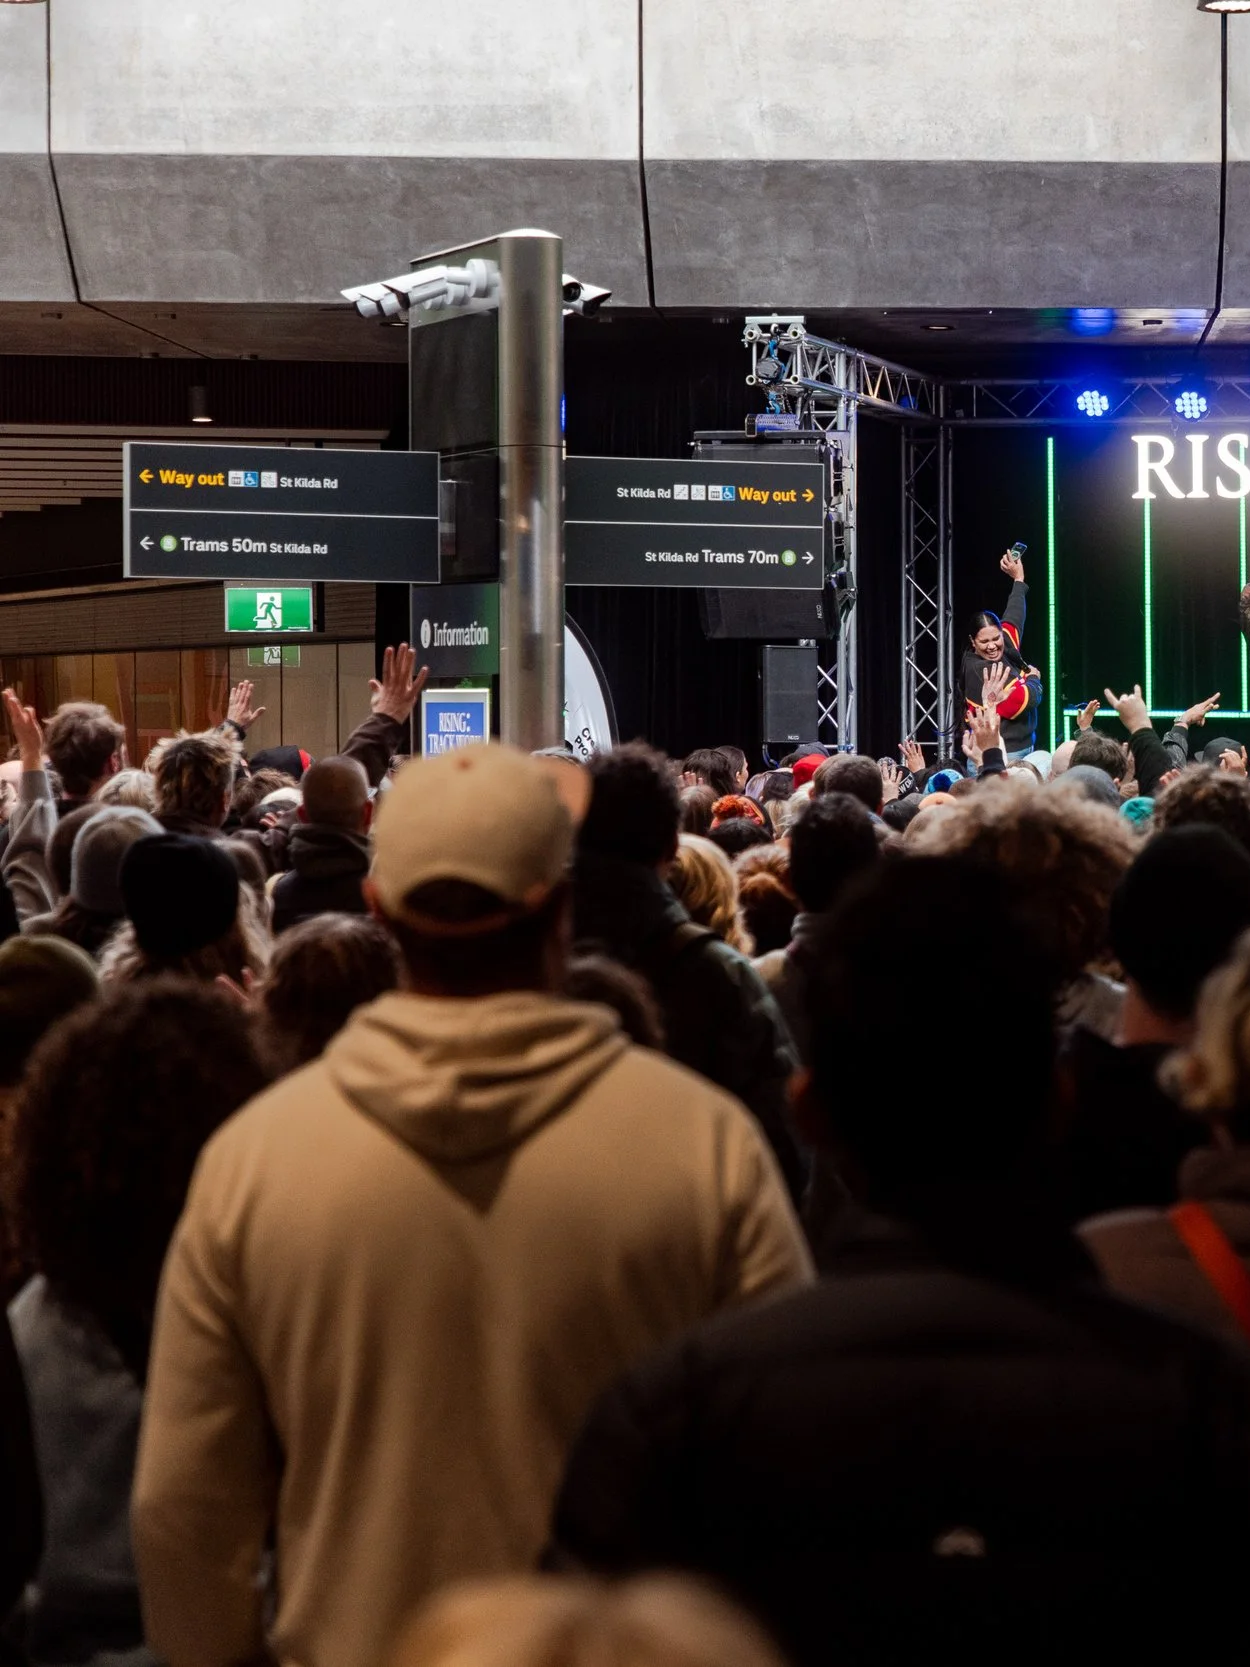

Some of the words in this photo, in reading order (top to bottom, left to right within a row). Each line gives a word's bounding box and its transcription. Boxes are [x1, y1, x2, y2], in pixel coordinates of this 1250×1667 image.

[159, 470, 195, 488] Way
[198, 473, 225, 485] out
[280, 477, 292, 487] St
[294, 478, 322, 488] Kilda
[323, 478, 338, 488] Rd
[617, 488, 628, 497] St
[631, 488, 656, 498] Kilda
[658, 488, 671, 498] Rd
[738, 487, 770, 504] Way
[772, 490, 797, 502] out
[181, 537, 229, 552] Trams
[232, 538, 267, 552] 50m
[270, 543, 282, 553] St
[284, 544, 311, 553] Kilda
[313, 544, 327, 554] Rd
[645, 552, 657, 561] St
[659, 552, 684, 562] Kilda
[685, 553, 699, 562] Rd
[702, 549, 745, 563] Trams
[748, 550, 779, 564] 70m
[434, 621, 489, 646] Information
